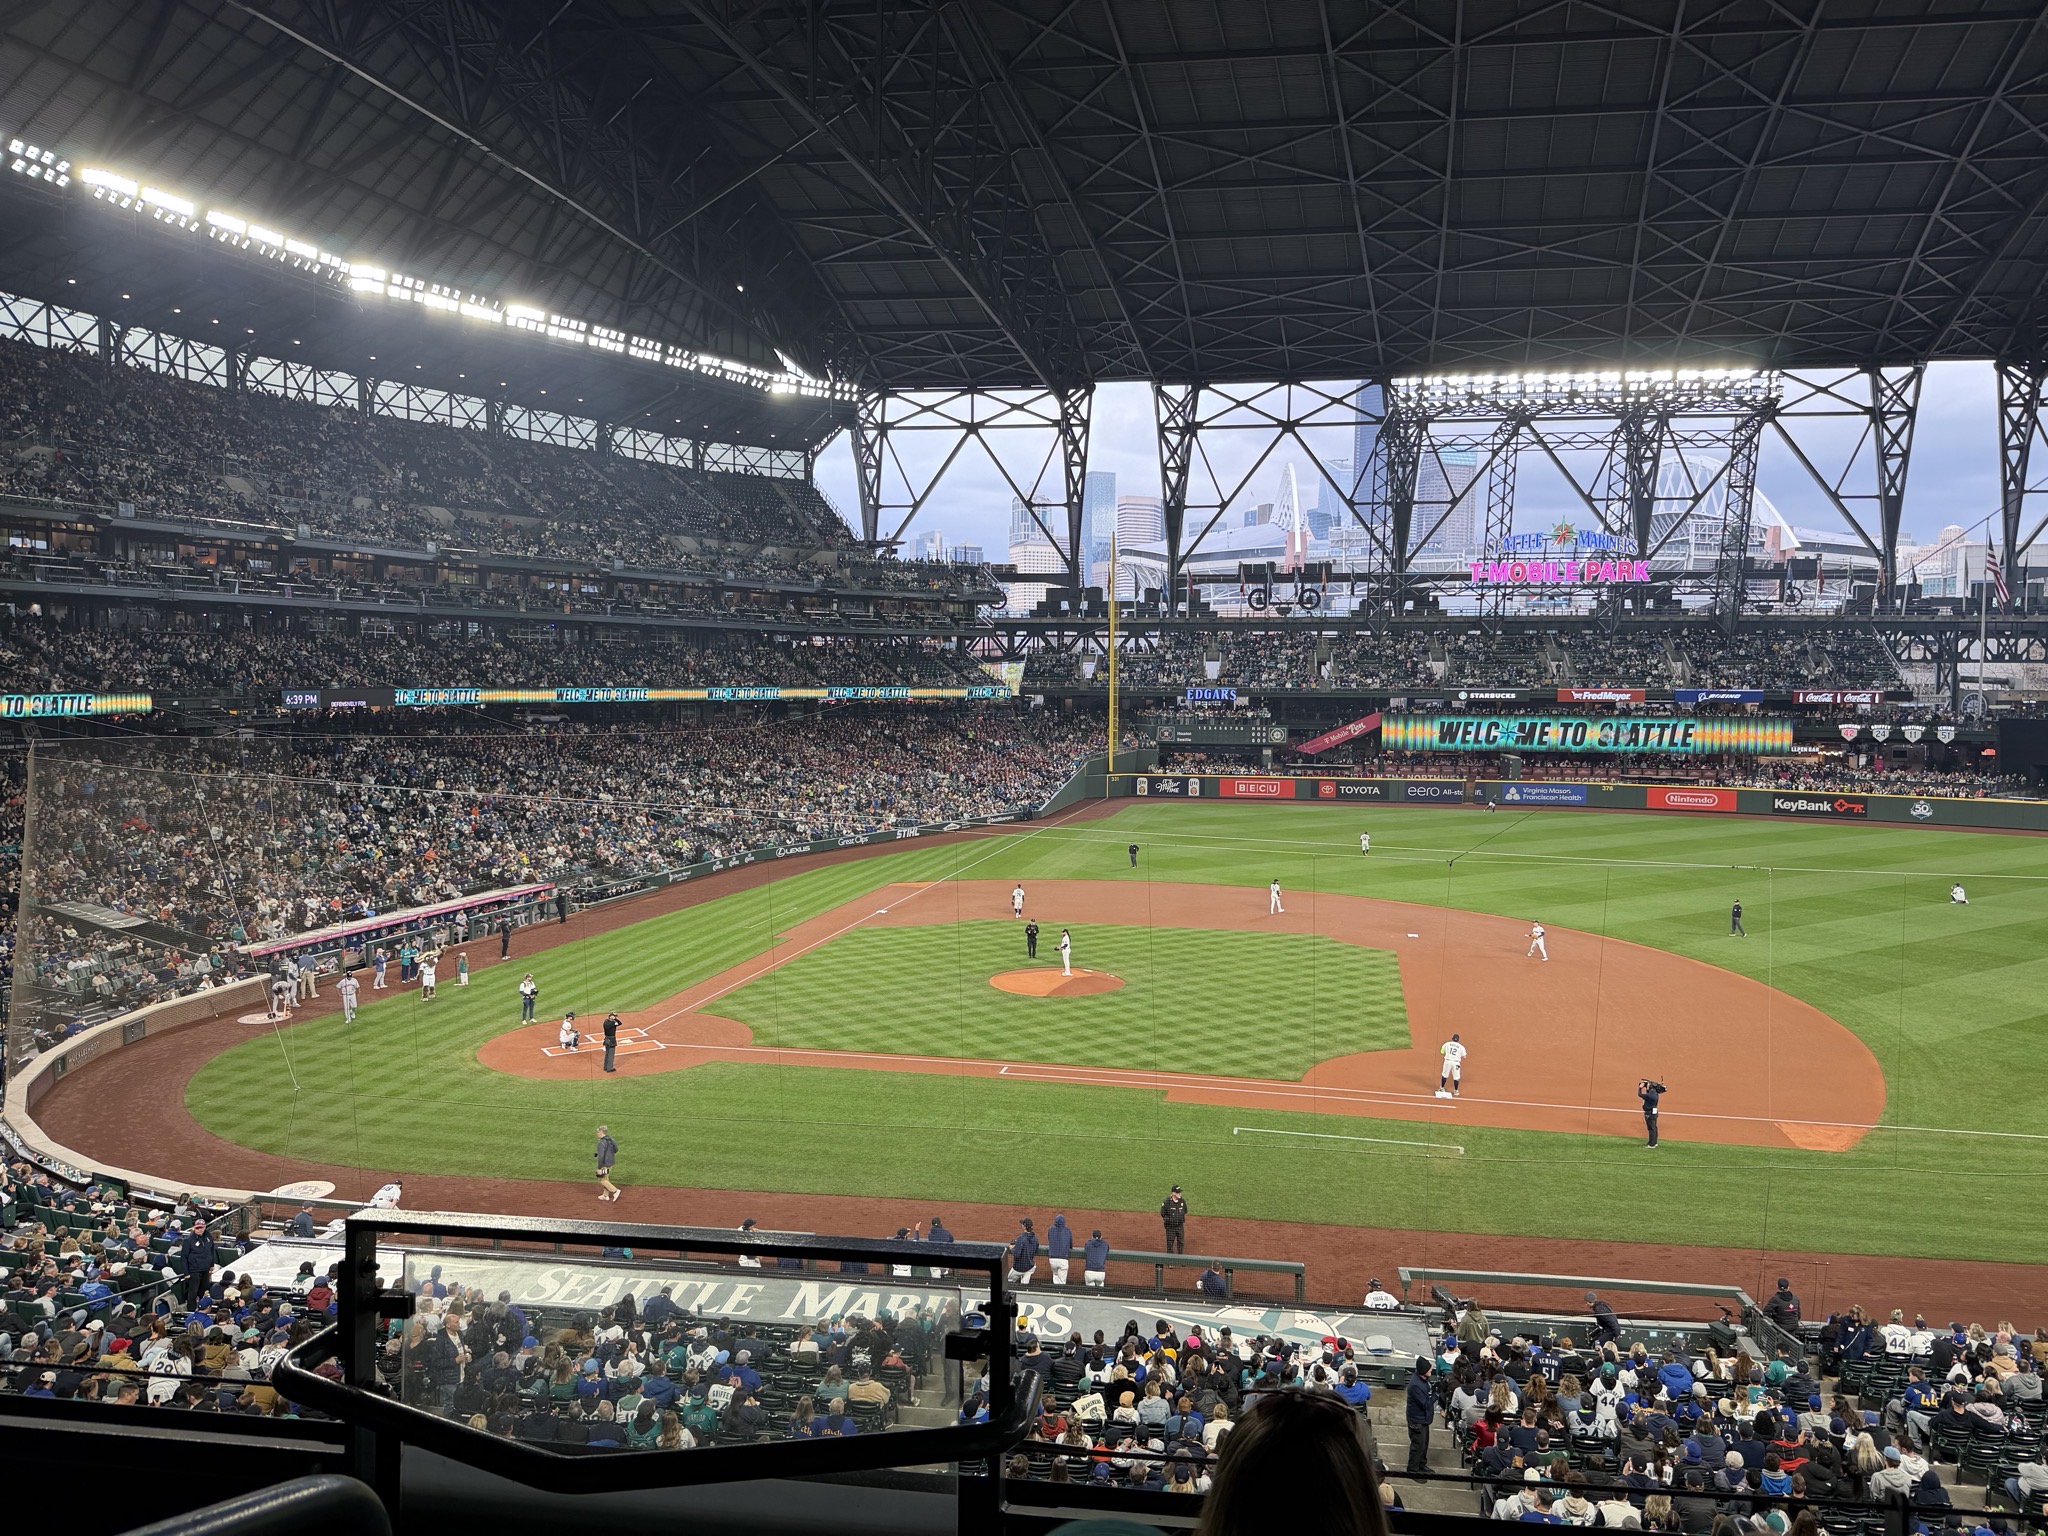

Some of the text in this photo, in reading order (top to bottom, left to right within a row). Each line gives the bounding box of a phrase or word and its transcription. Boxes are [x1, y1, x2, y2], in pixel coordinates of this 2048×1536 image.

[1486, 530, 1639, 555] SEATTLE MARINERS
[1468, 560, 1652, 582] T-MOBILE PARK
[429, 689, 440, 704] TO
[556, 689, 598, 701] WELCME
[602, 689, 612, 701] TO
[707, 688, 742, 699] WELCME
[742, 688, 751, 699] TO
[827, 687, 864, 698] WELCME
[866, 687, 876, 698] TO
[966, 687, 1012, 698] WELCME TO
[285, 694, 317, 705] 6:39 PM
[5, 696, 25, 716] TO
[1438, 721, 1551, 746] WELCME
[1559, 722, 1588, 747] TO
[1875, 730, 1886, 738] 24
[1941, 732, 1951, 740] 51
[1339, 785, 1380, 795] TOYOTA
[1408, 786, 1440, 797] eero
[1669, 795, 1714, 805] Nintendo
[1774, 799, 1832, 813] KeyBank
[1915, 804, 1929, 813] 50
[896, 828, 920, 839] STIHL
[838, 836, 869, 846] Great Clips
[785, 845, 811, 855] LEXUS
[1449, 1047, 1458, 1056] 12
[519, 1267, 764, 1318] SEATTLE
[1889, 1337, 1906, 1351] 44
[688, 1358, 704, 1370] 34
[1538, 1358, 1559, 1367] ICHIRO
[1542, 1366, 1555, 1381] 51
[1601, 1396, 1616, 1407] 44
[1920, 1393, 1939, 1408] 44
